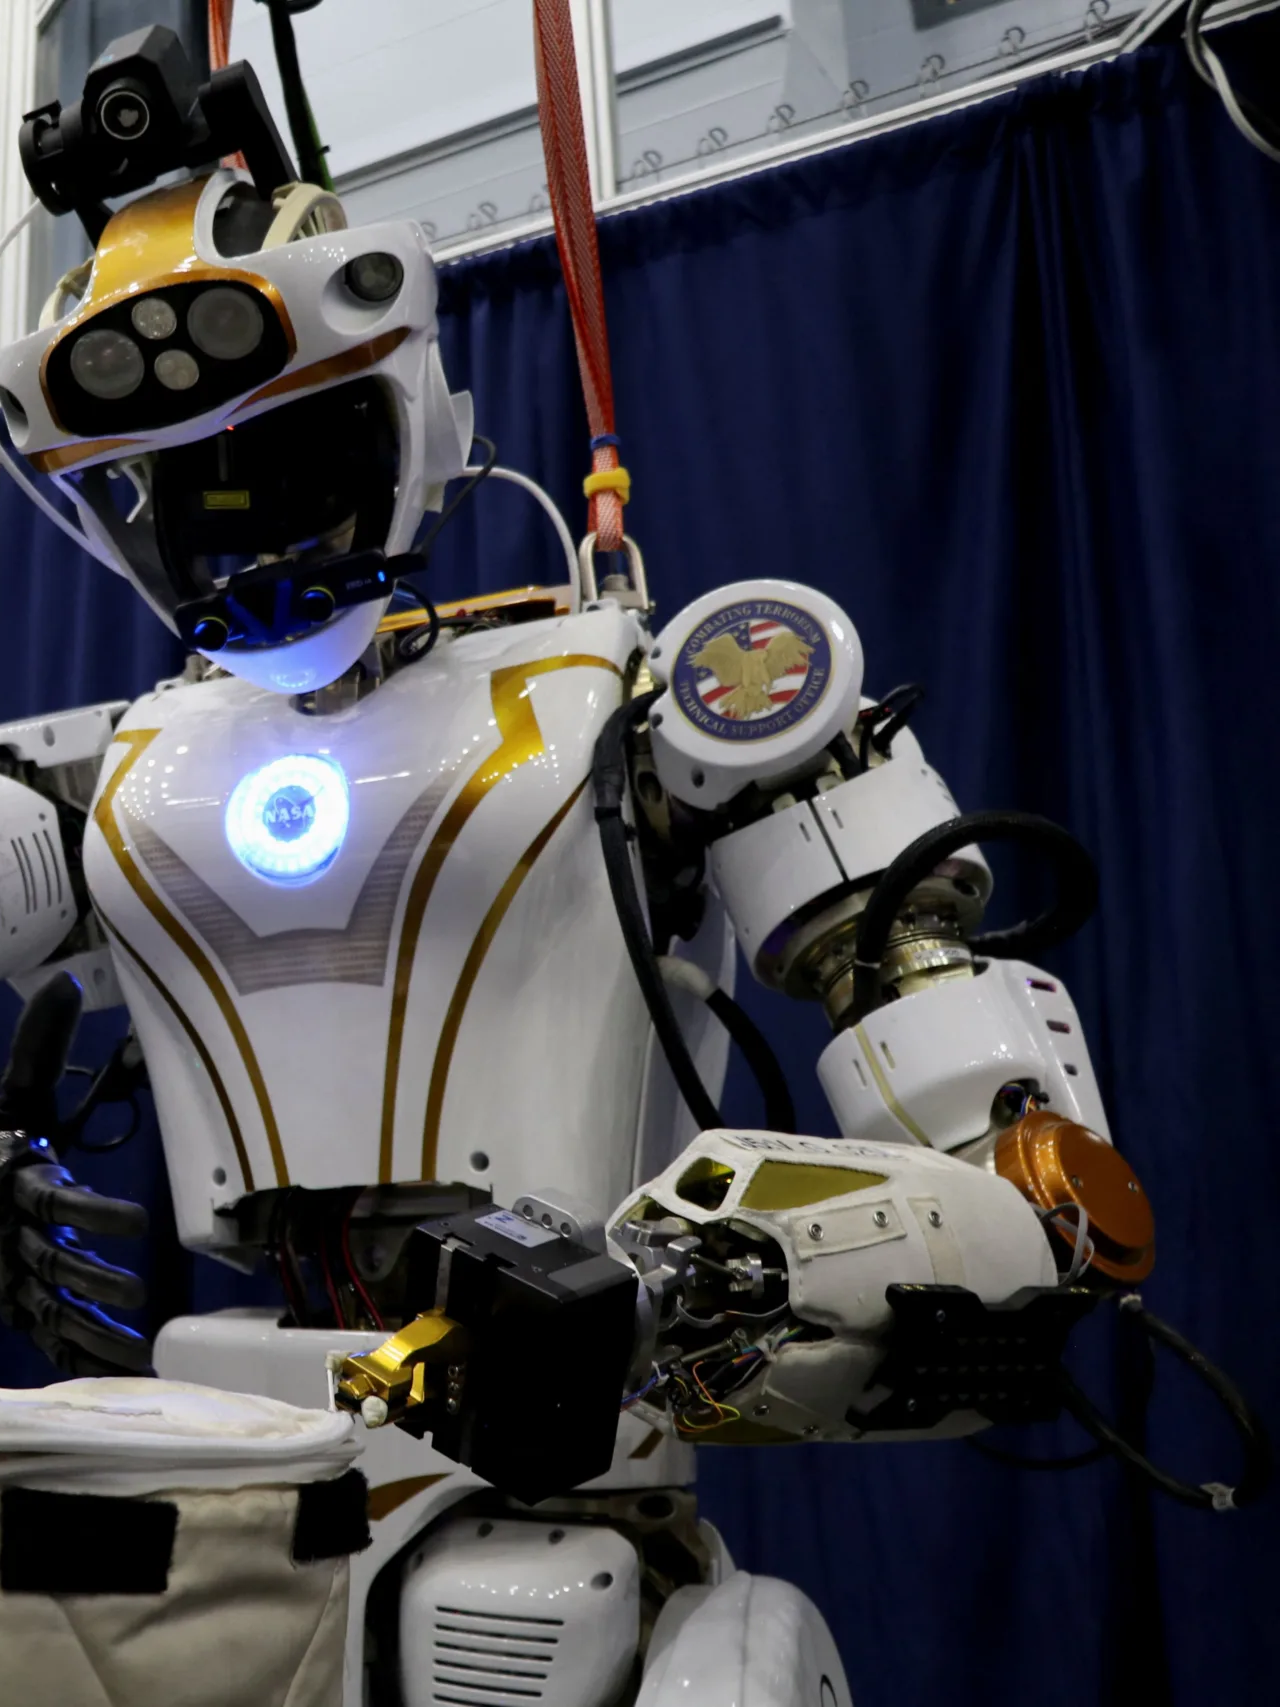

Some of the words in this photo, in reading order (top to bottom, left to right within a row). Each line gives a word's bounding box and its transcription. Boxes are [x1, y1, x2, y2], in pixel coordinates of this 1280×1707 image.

[685, 605, 752, 655] COMBATING
[756, 603, 821, 645] TERRORISM
[679, 681, 728, 735] TECHNICAL
[731, 712, 794, 737] SUPPORT
[794, 667, 826, 715] OFFICE
[265, 804, 315, 824] NASA
